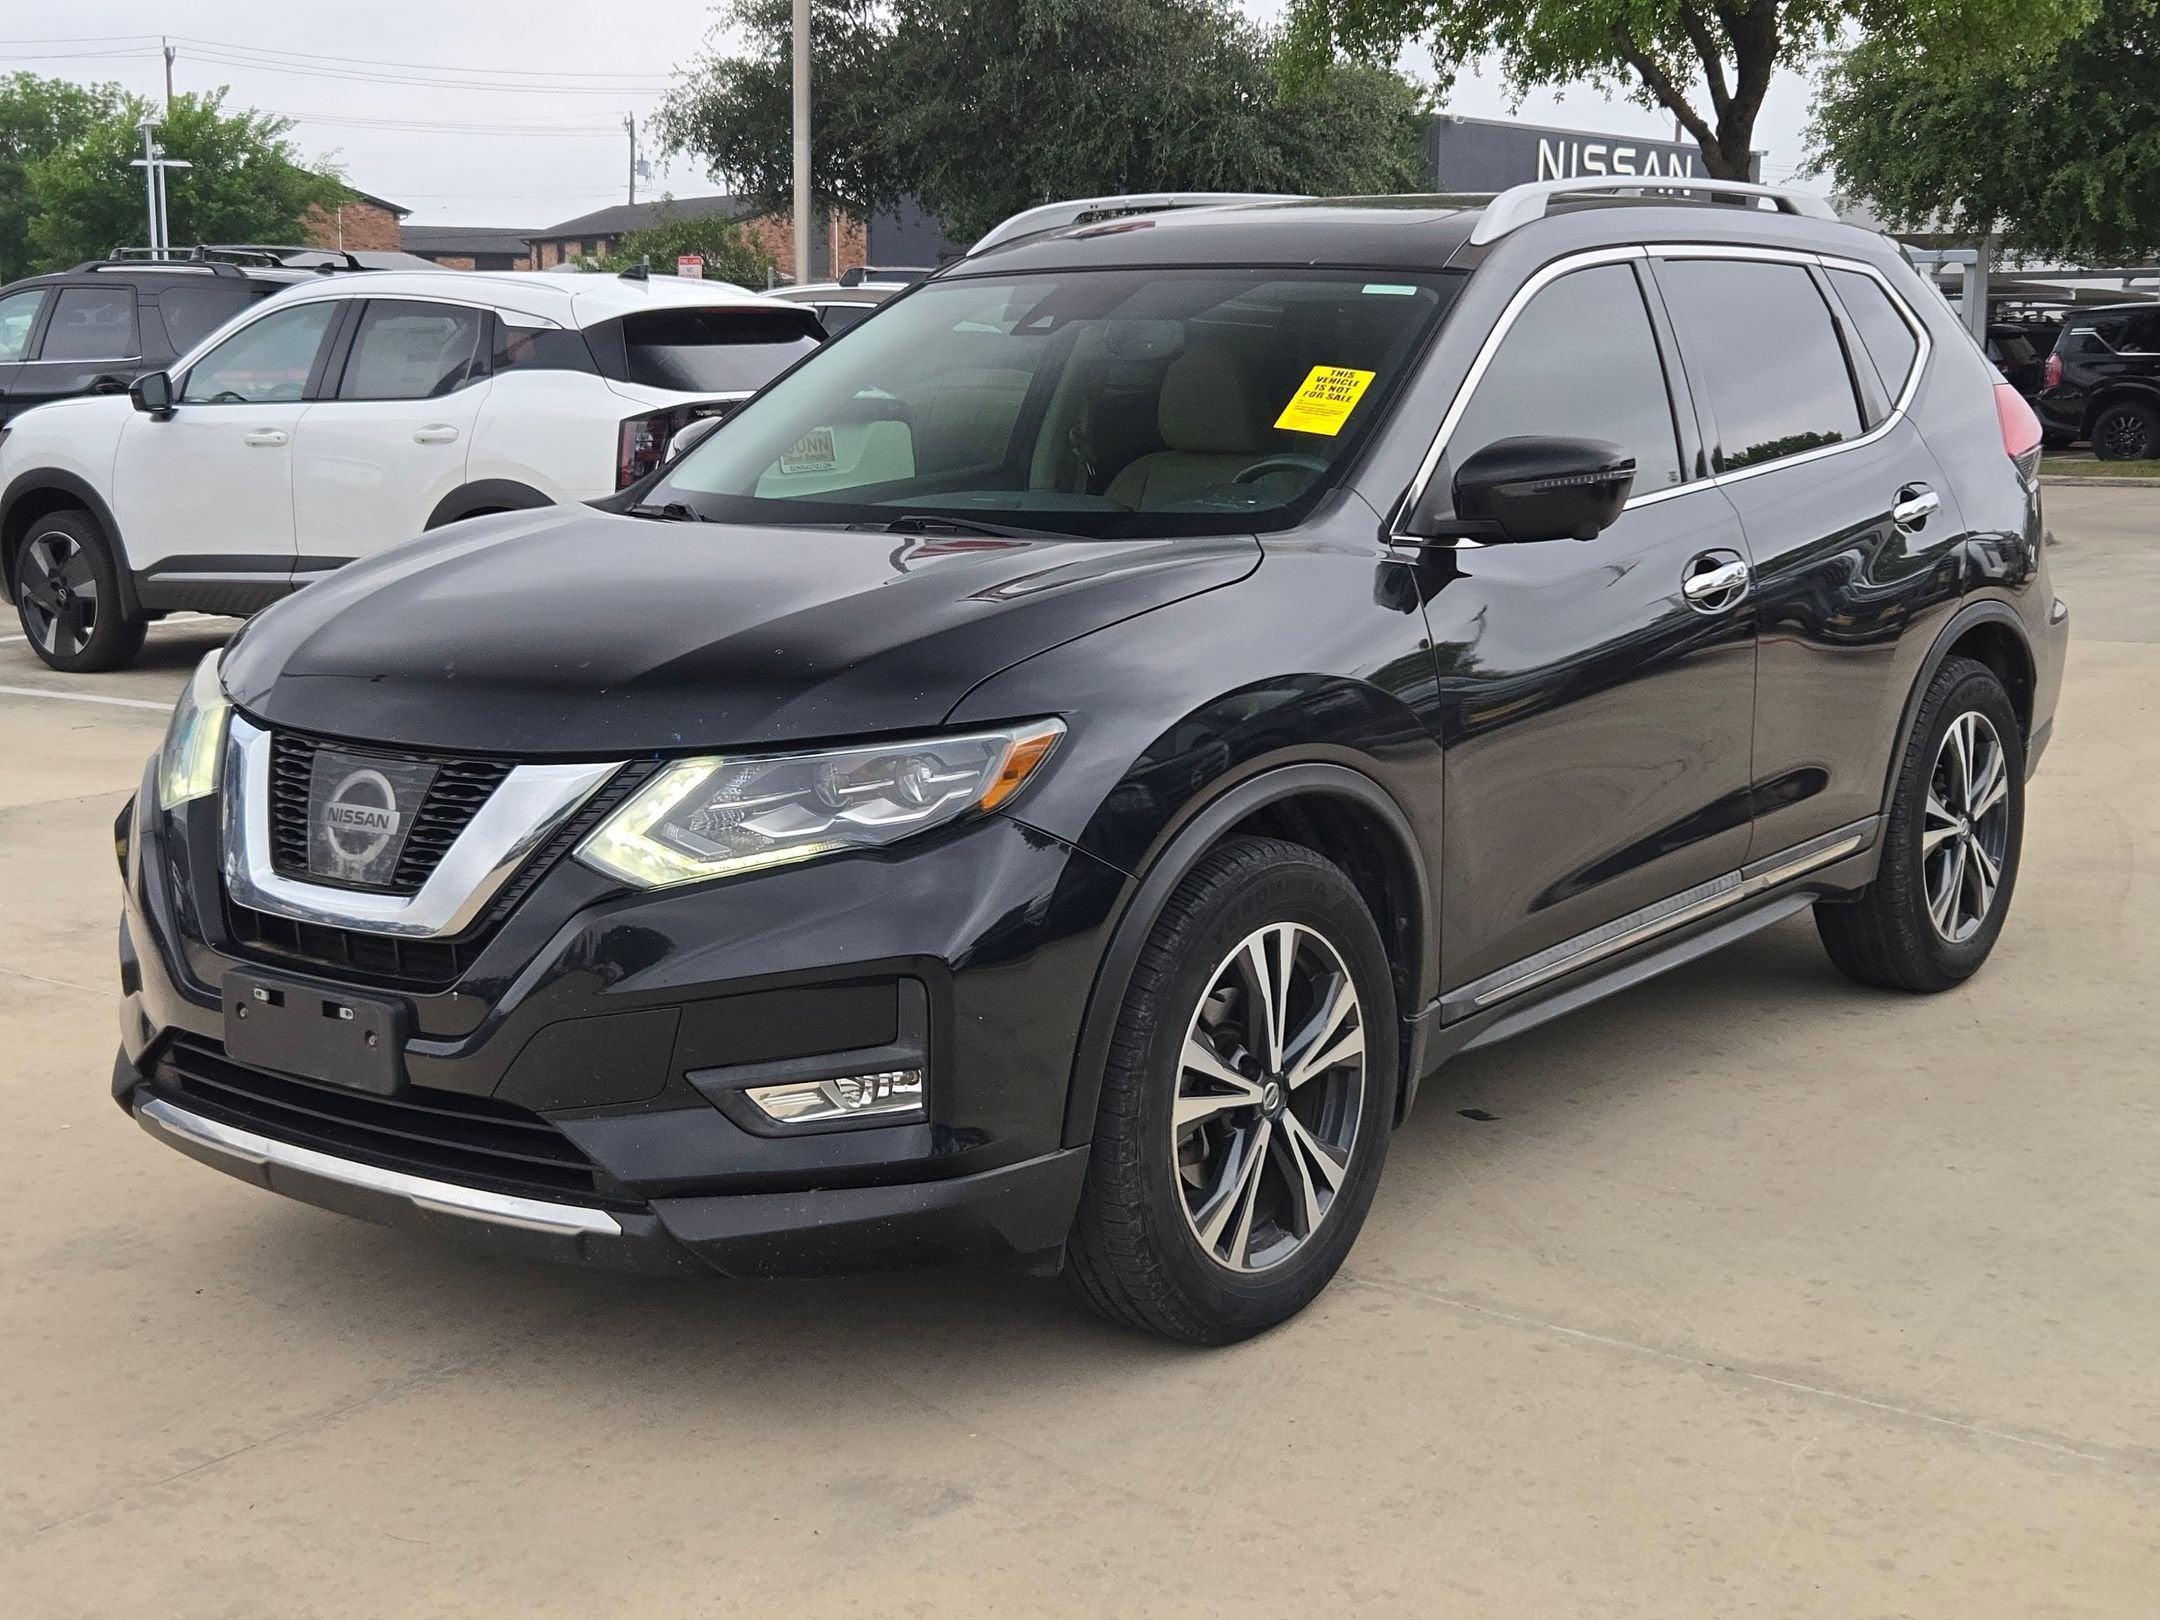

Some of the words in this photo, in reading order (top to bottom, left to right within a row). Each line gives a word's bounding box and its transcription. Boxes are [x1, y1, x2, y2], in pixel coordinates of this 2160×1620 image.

[1538, 138, 1692, 196] NISSAN
[1330, 369, 1356, 379] THIS
[1316, 376, 1360, 387] VEHICLE
[1328, 385, 1352, 394] NOT
[1302, 390, 1325, 399] FOR
[1326, 393, 1354, 403] SALE
[327, 807, 390, 829] NISSAN
